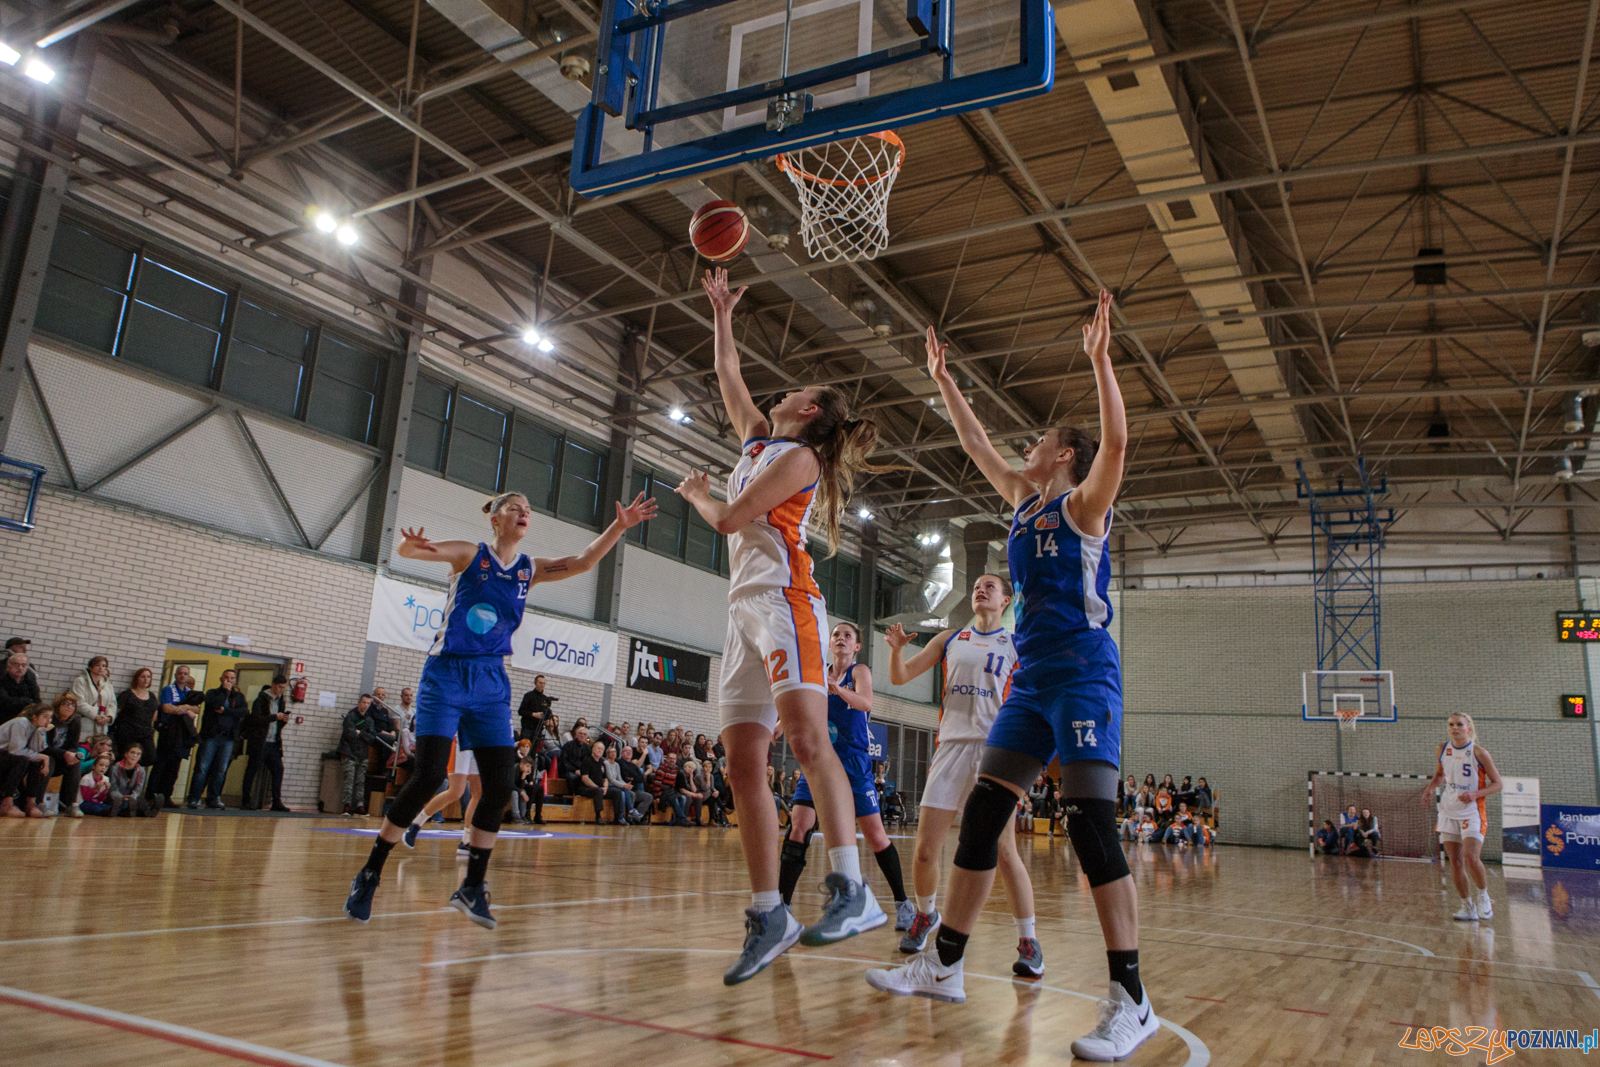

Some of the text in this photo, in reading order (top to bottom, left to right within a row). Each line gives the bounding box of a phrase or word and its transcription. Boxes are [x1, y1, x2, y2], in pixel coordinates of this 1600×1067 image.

[1035, 532, 1059, 558] 14
[413, 605, 444, 632] po
[1562, 619, 1574, 628] 35
[984, 652, 1004, 678] 11
[1574, 704, 1583, 714] 8
[1075, 728, 1097, 747] 14
[868, 743, 882, 756] ea
[1462, 763, 1472, 777] 5
[1559, 811, 1595, 823] kantor
[1461, 819, 1470, 830] 5
[1565, 831, 1600, 846] Pom
